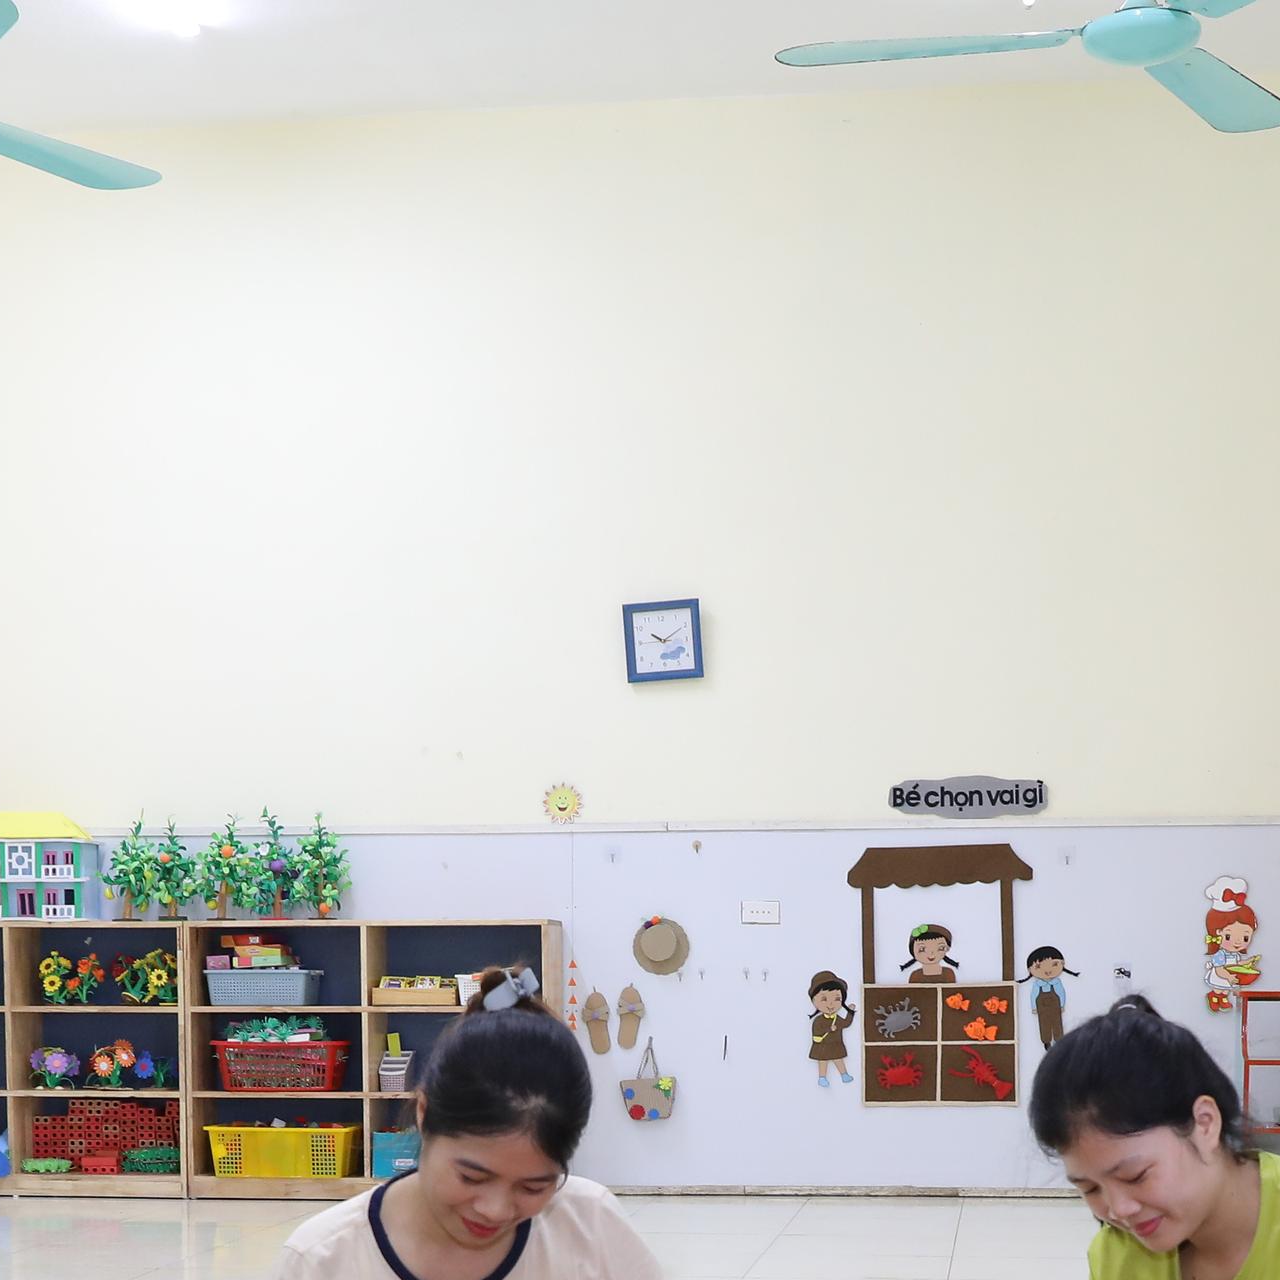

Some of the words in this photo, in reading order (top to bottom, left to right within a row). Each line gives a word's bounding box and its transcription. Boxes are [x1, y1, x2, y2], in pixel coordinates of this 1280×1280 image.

[892, 783, 920, 808] Bé
[924, 786, 983, 812] chọn
[987, 784, 1020, 806] vai
